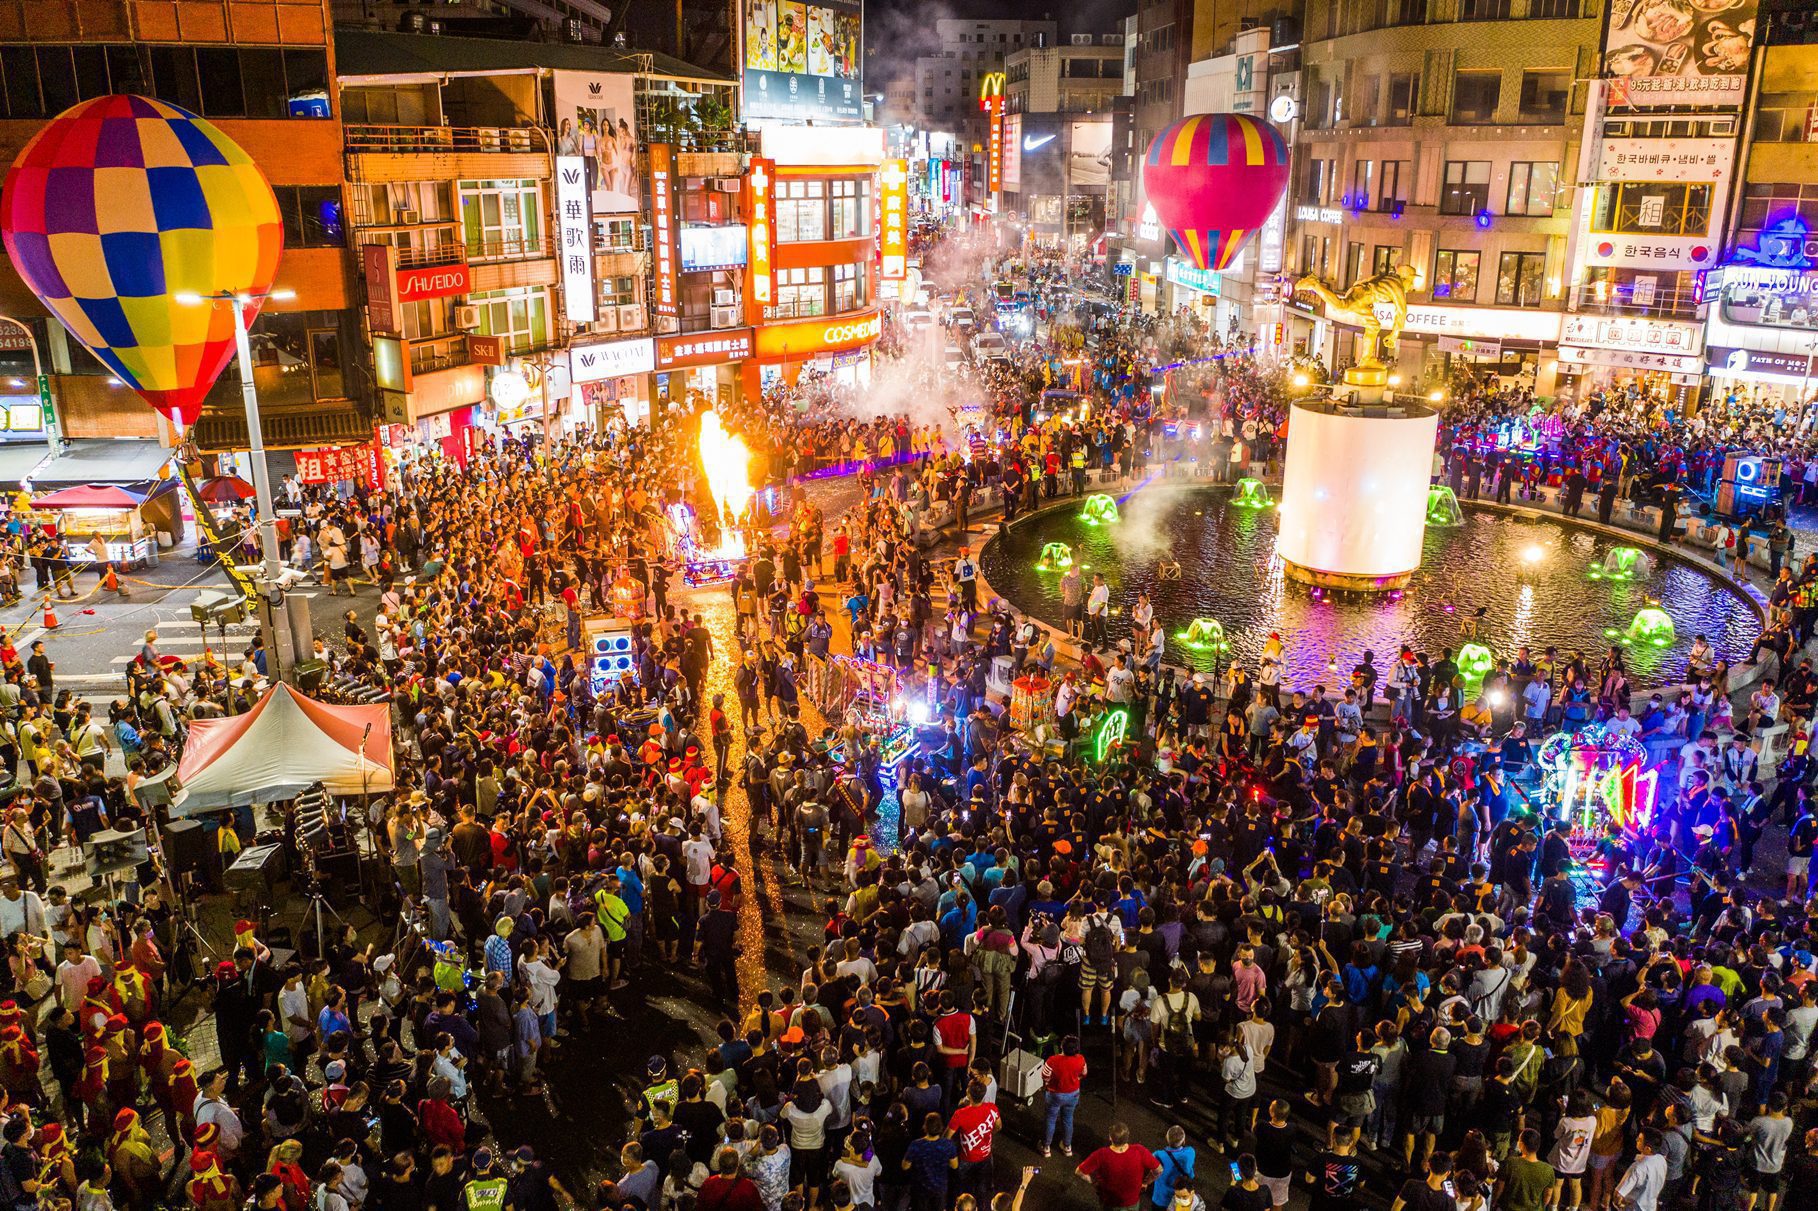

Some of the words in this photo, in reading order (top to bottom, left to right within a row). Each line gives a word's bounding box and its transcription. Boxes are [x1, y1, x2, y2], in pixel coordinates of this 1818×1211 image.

[1641, 199, 1662, 225] 租
[1624, 245, 1681, 259] 한국음식
[400, 272, 464, 295] SHISEIDO
[1635, 279, 1653, 303] 租
[1731, 272, 1760, 289] SUN
